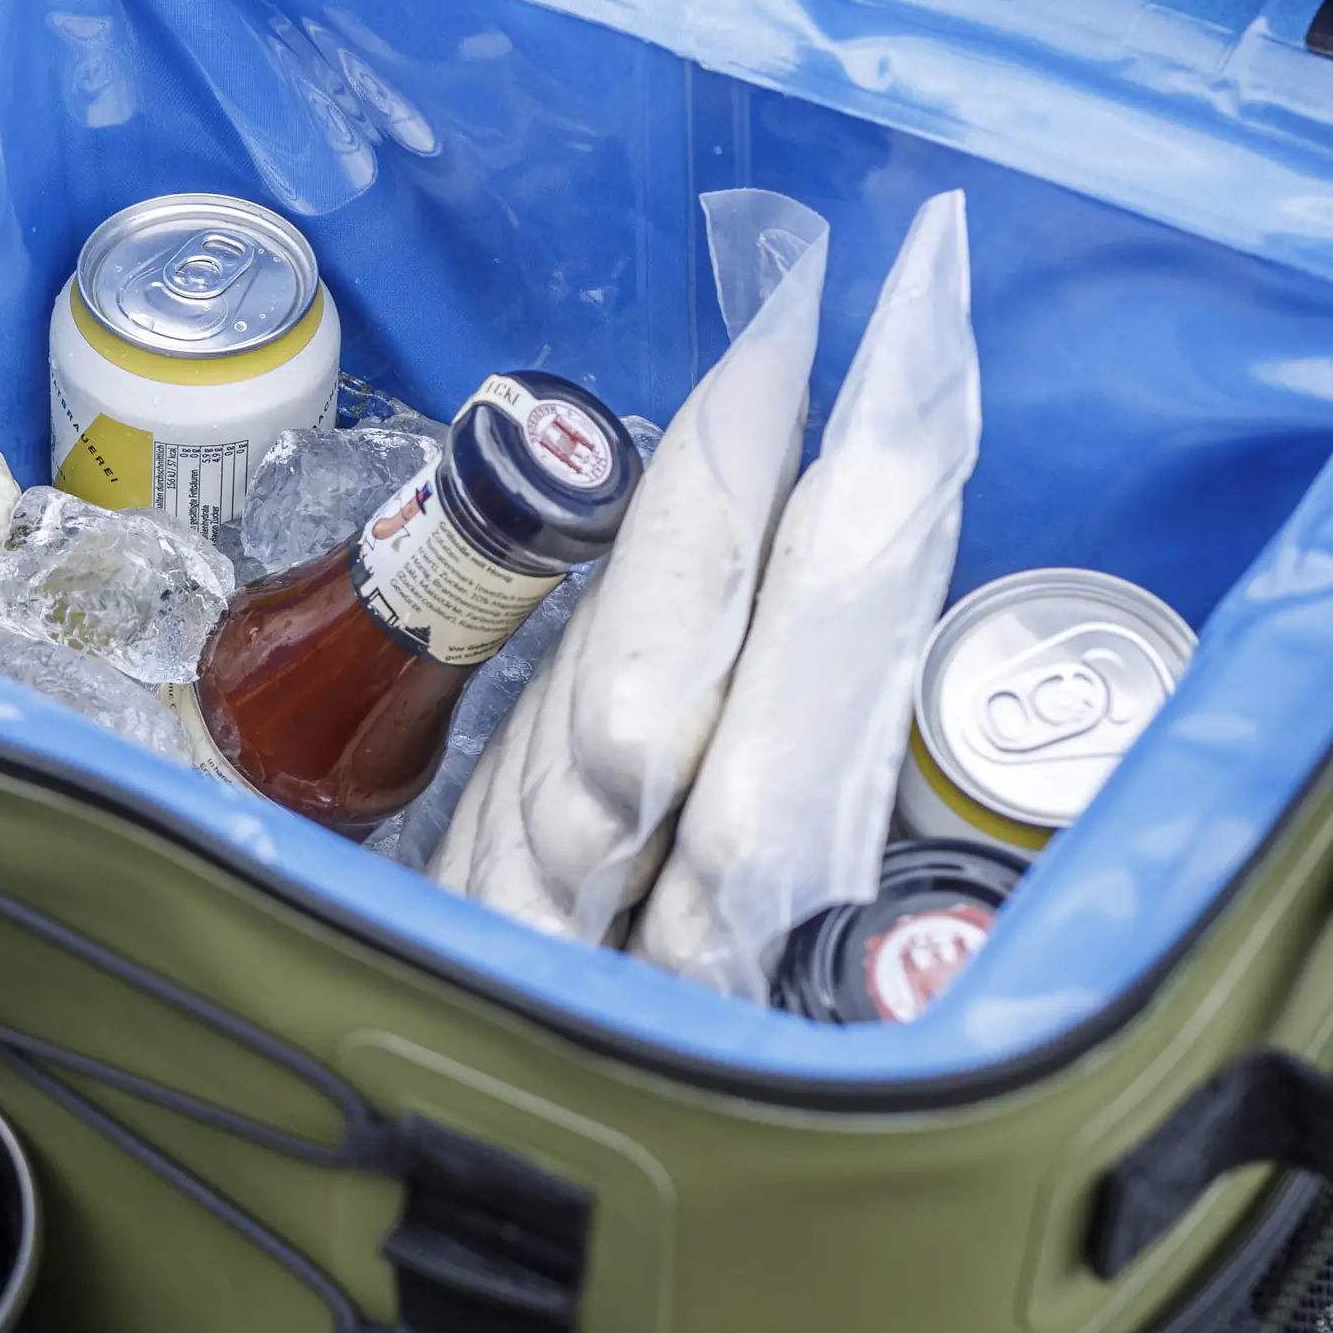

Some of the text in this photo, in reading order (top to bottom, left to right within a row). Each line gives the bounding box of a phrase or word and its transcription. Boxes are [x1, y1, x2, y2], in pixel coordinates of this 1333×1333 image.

[155, 445, 164, 492] durchschnittlich
[166, 478, 175, 490] 156
[188, 469, 198, 498] Fettsäuren
[210, 506, 219, 524] Zucker
